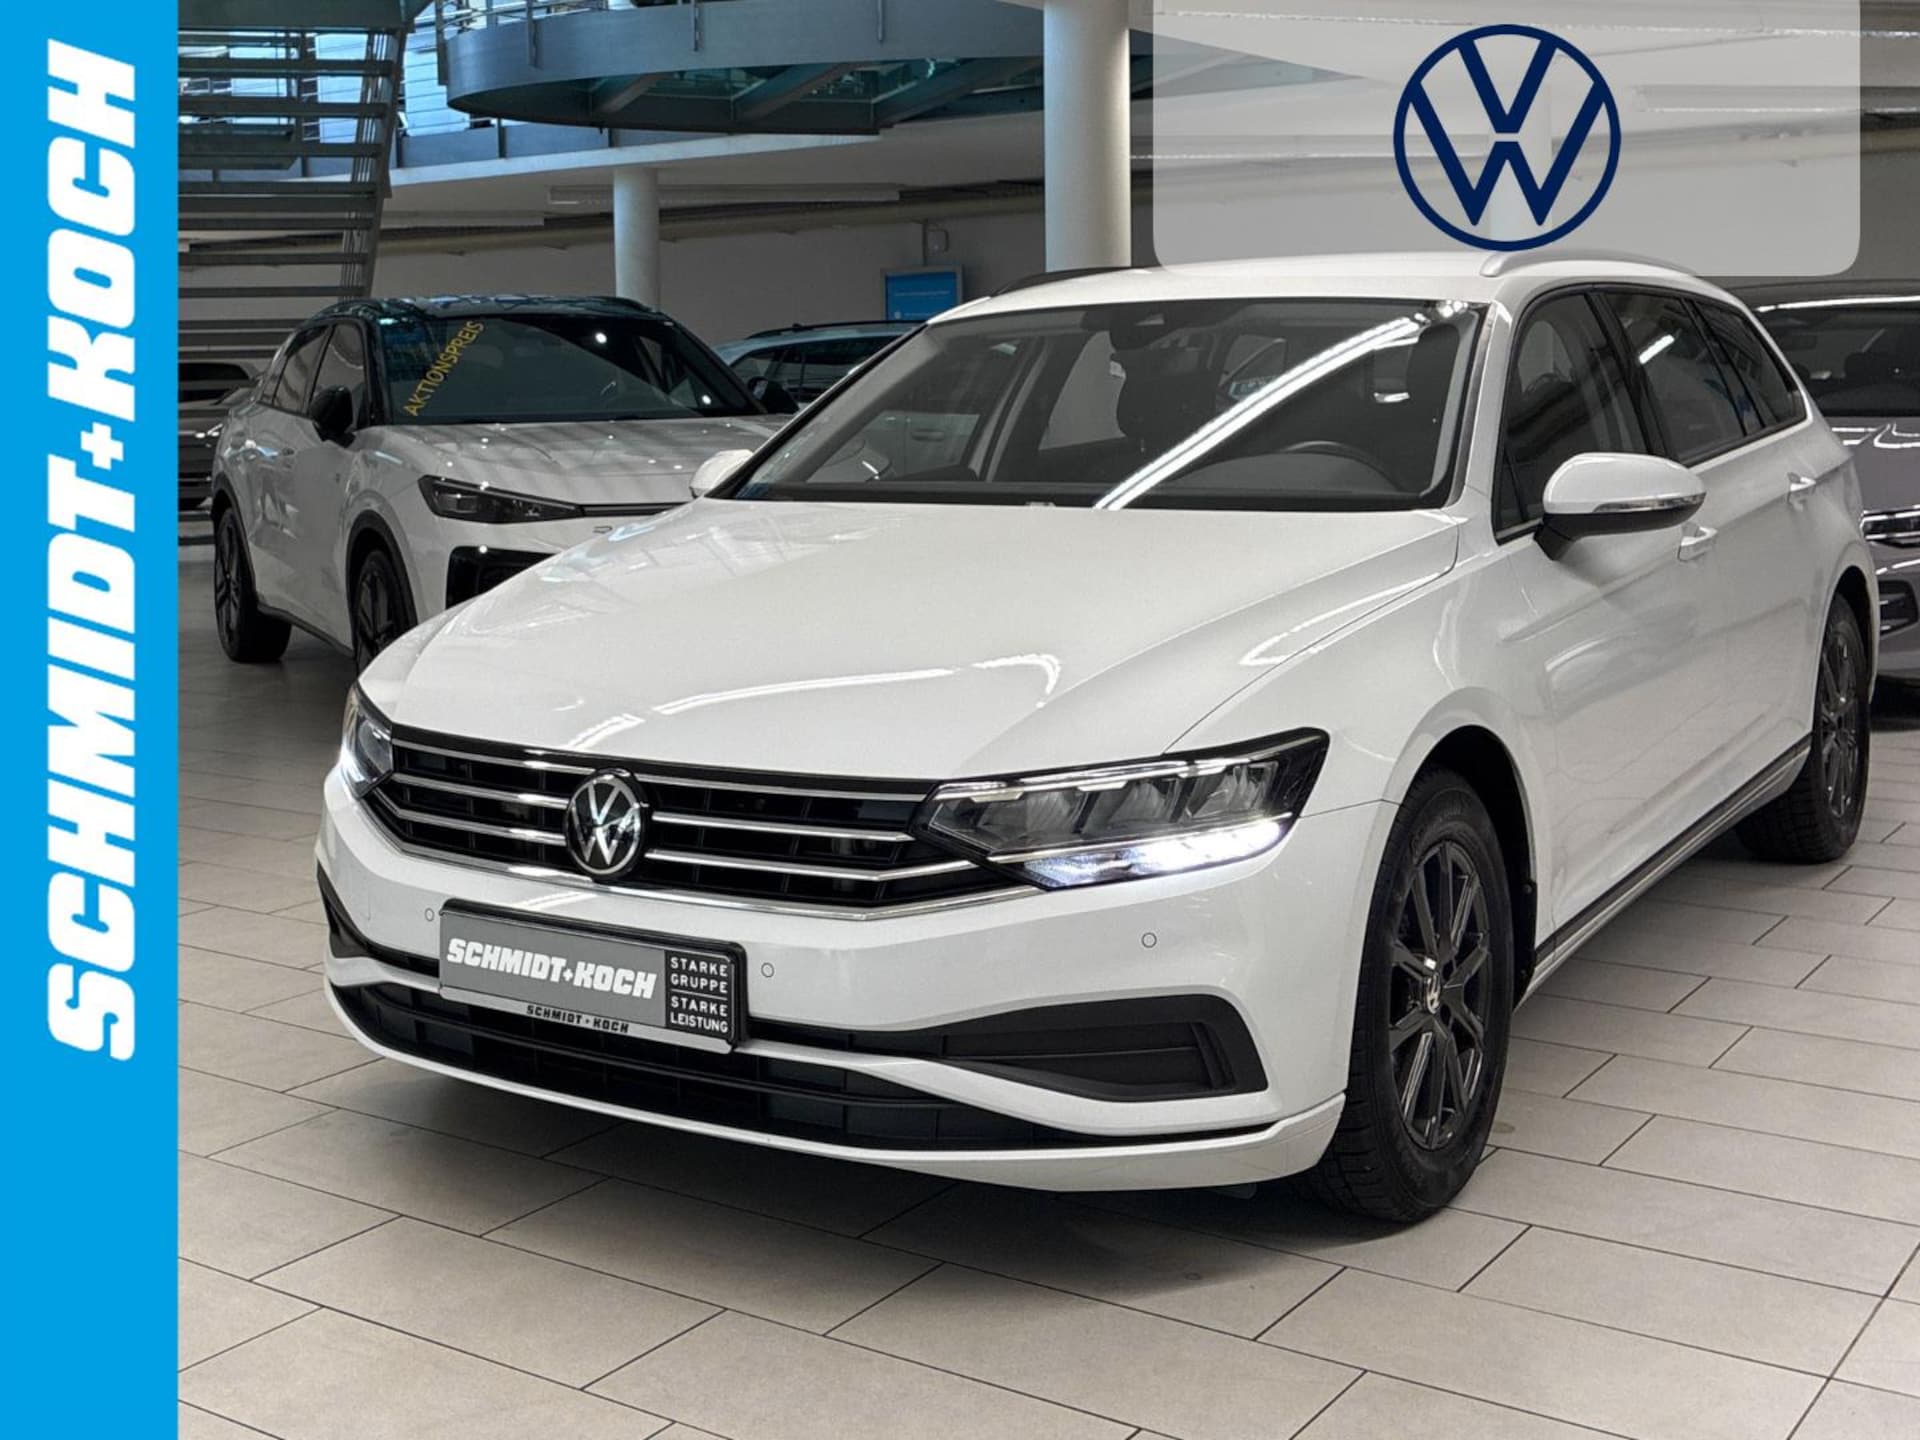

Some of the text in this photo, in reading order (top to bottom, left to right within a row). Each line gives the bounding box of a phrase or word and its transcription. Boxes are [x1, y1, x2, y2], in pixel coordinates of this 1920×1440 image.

[403, 320, 484, 416] AKTIONSPREIS
[446, 937, 657, 999] SCHMIDT+KOCH
[670, 955, 729, 977] STARKE
[670, 972, 729, 994] GRUPPE
[670, 995, 729, 1018] STARKE
[526, 1004, 582, 1025] SCHMIDT
[593, 1017, 630, 1033] KOCH
[670, 1013, 729, 1034] LEISTUNG
